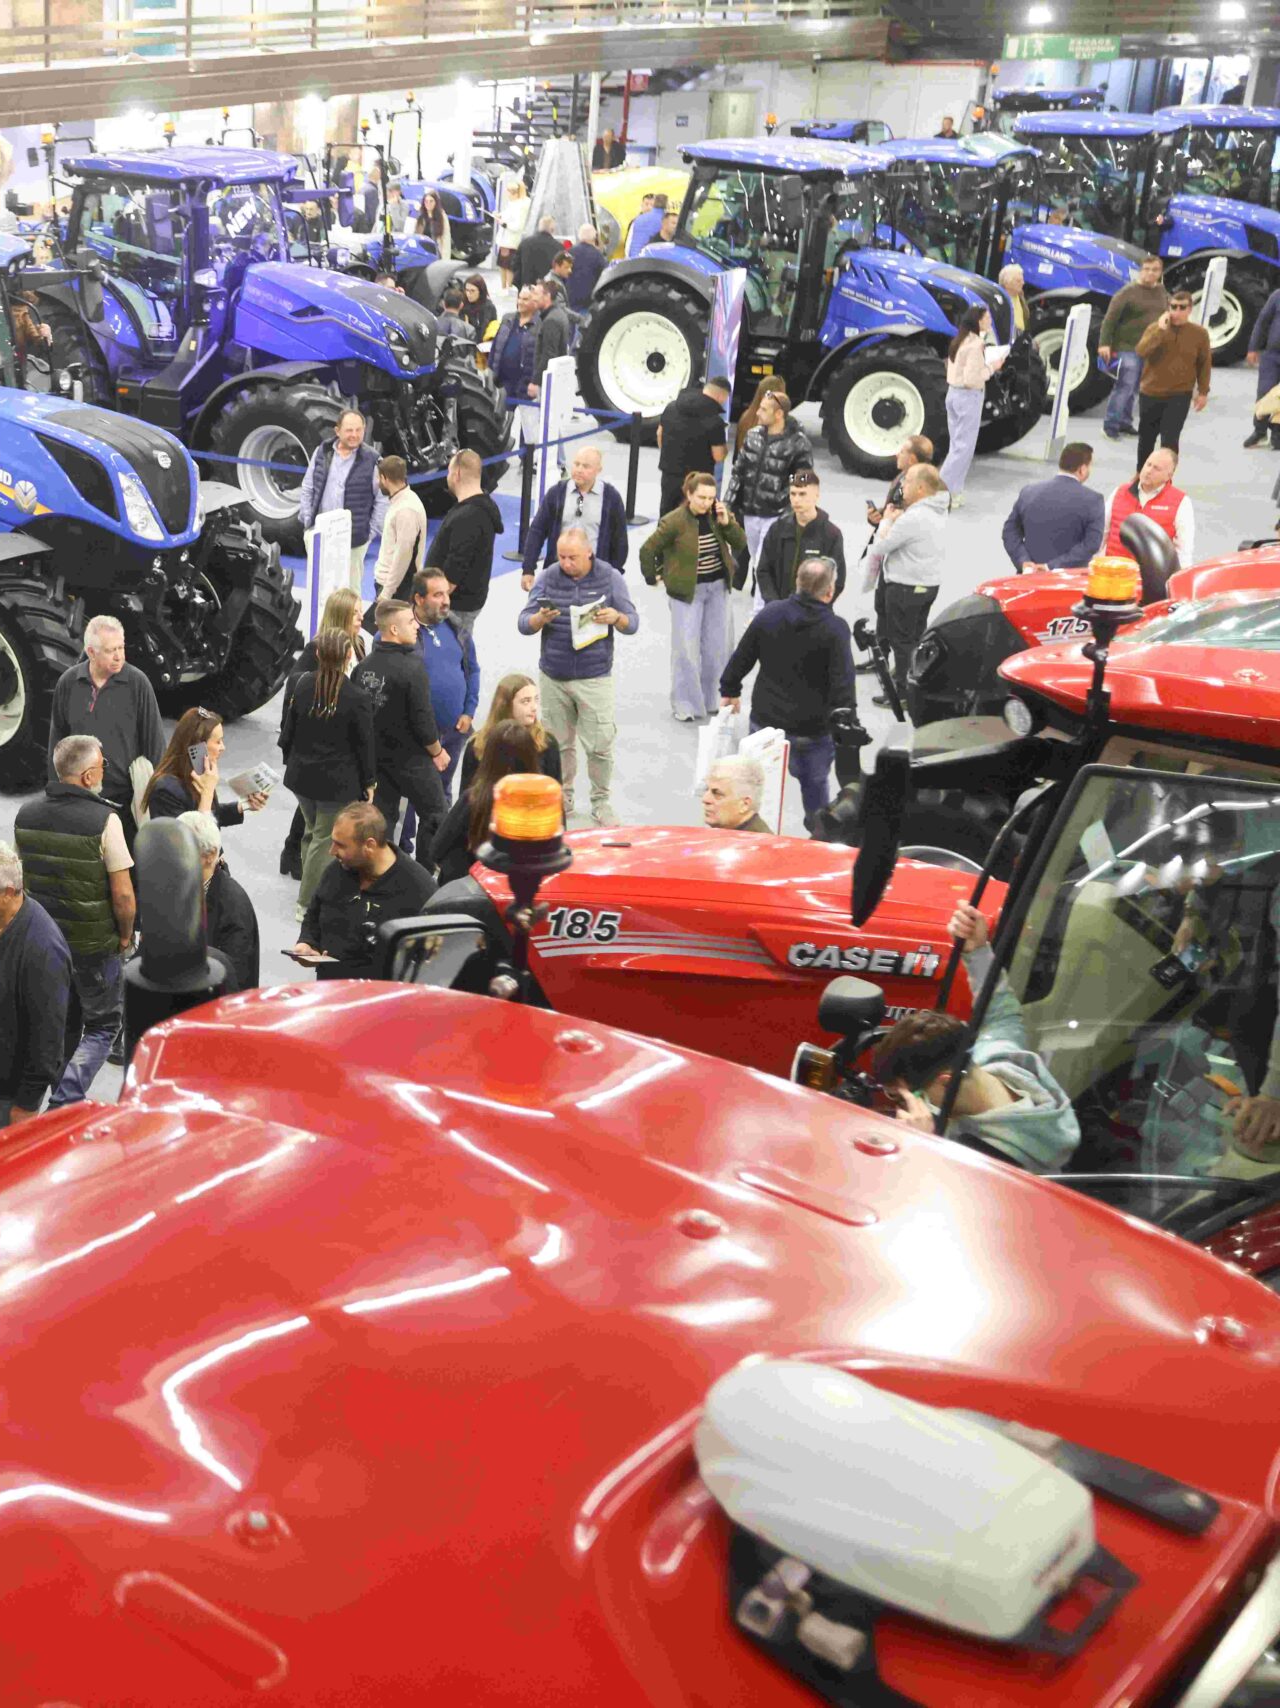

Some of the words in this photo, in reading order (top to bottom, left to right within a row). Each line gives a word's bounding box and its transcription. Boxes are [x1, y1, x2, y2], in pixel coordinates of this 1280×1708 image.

[225, 197, 257, 239] NEW
[1047, 616, 1092, 636] 175
[547, 906, 623, 945] 185
[787, 941, 900, 974] CASE
